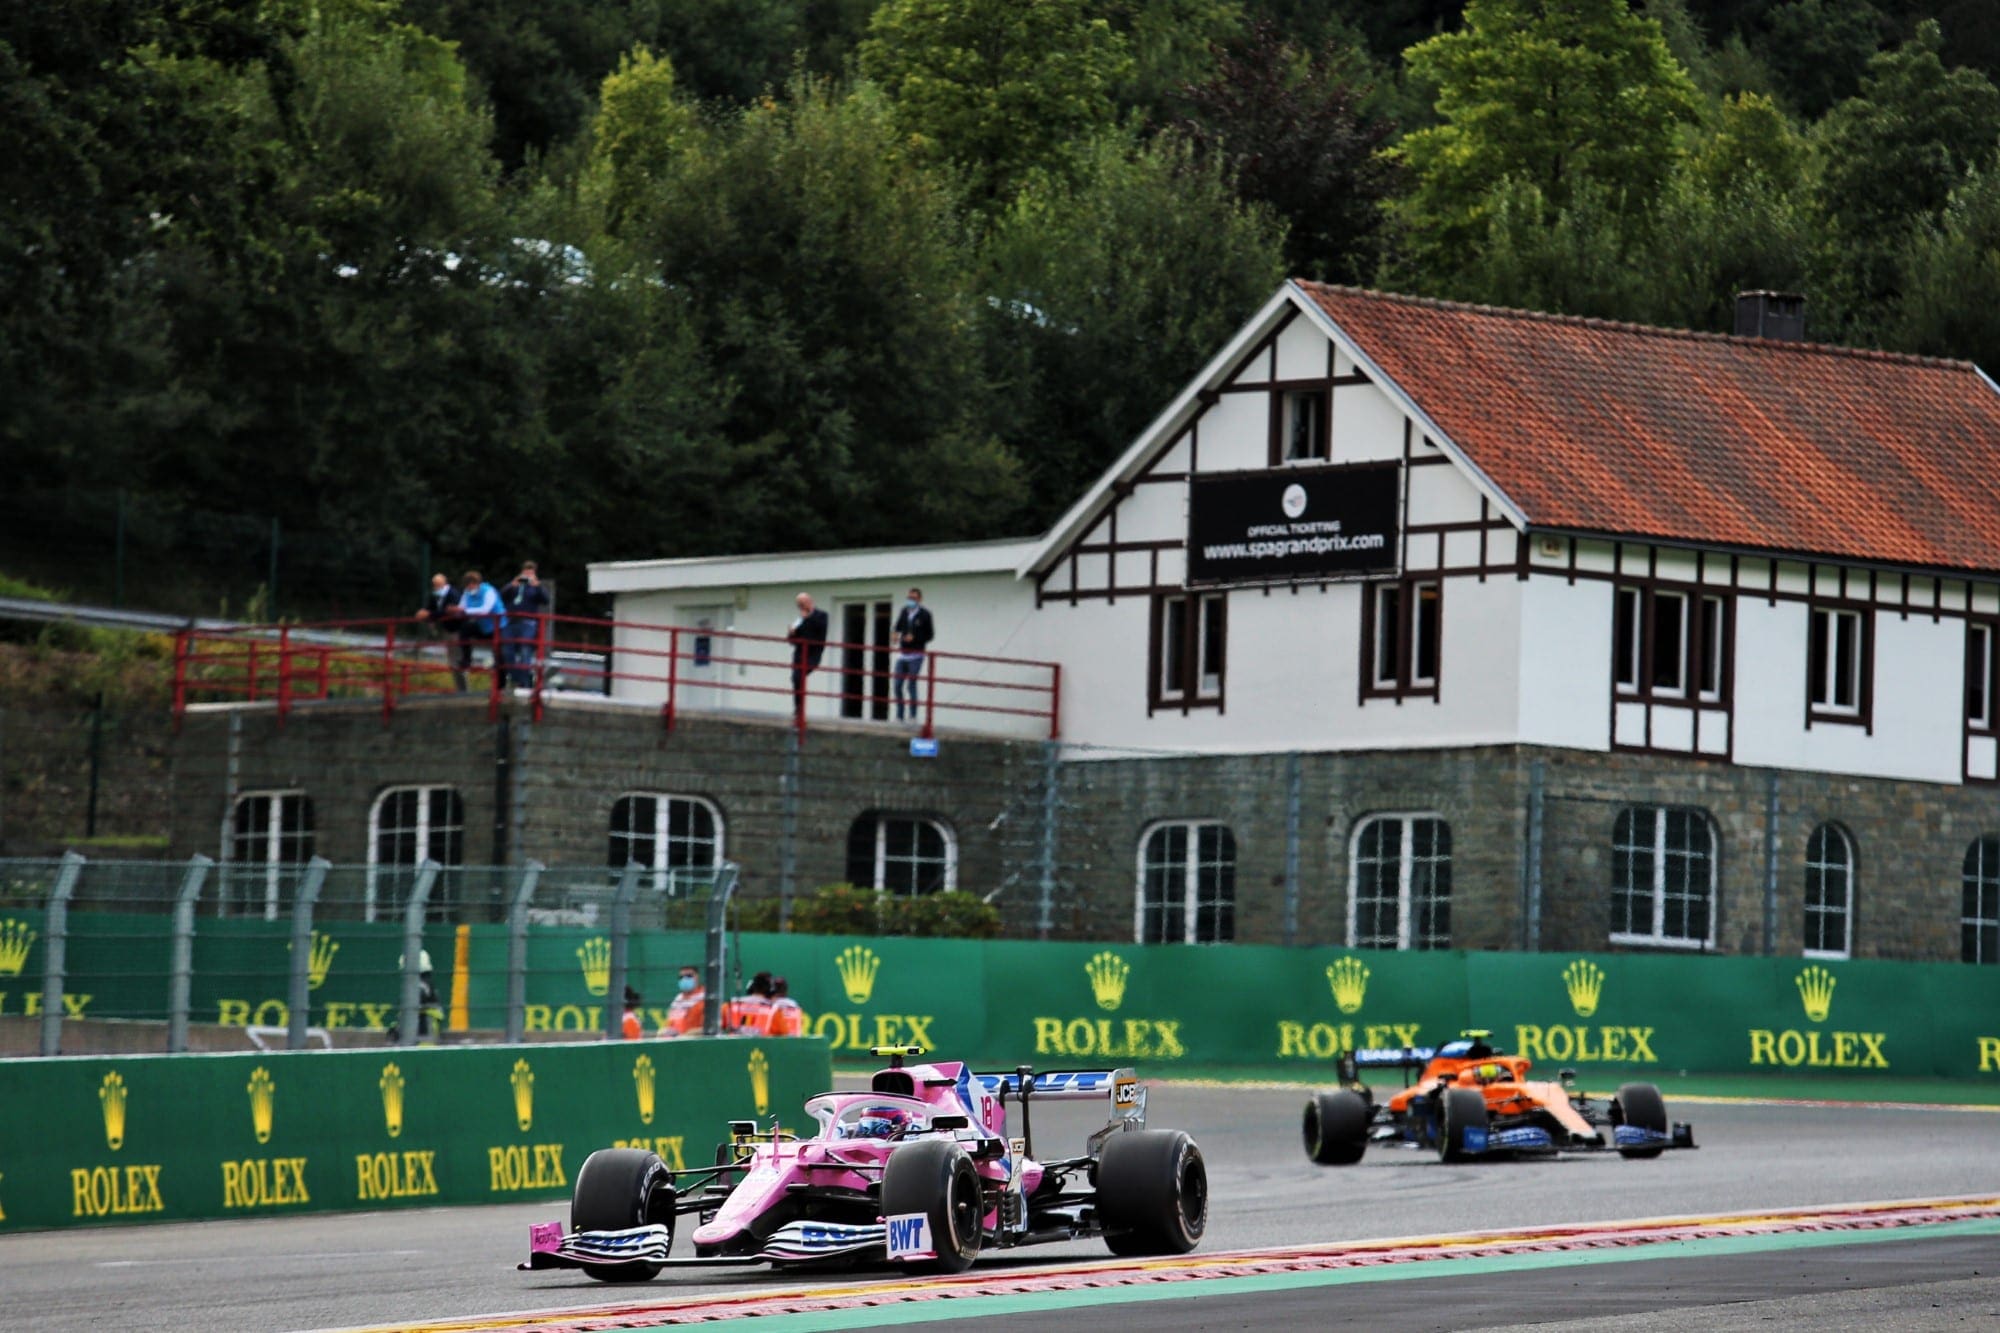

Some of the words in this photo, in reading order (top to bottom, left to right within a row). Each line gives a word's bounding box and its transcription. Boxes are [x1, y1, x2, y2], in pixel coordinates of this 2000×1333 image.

[1203, 533, 1384, 560] www.spagrandprix.com
[1247, 523, 1289, 538] OFFICIAL
[1290, 520, 1341, 535] TICKETING
[218, 998, 393, 1032] ROEX
[1033, 1016, 1185, 1058] ROLEX
[1515, 1024, 1658, 1063] ROLEX
[1749, 1029, 1889, 1068] ROLEX
[980, 1095, 993, 1131] 18
[1116, 1084, 1136, 1103] JCB
[221, 1157, 311, 1208] ROLEX
[356, 1150, 440, 1200] ROLEX
[488, 1143, 567, 1192] ROLEX
[71, 1164, 165, 1217] ROLEX
[890, 1217, 924, 1252] BWT
